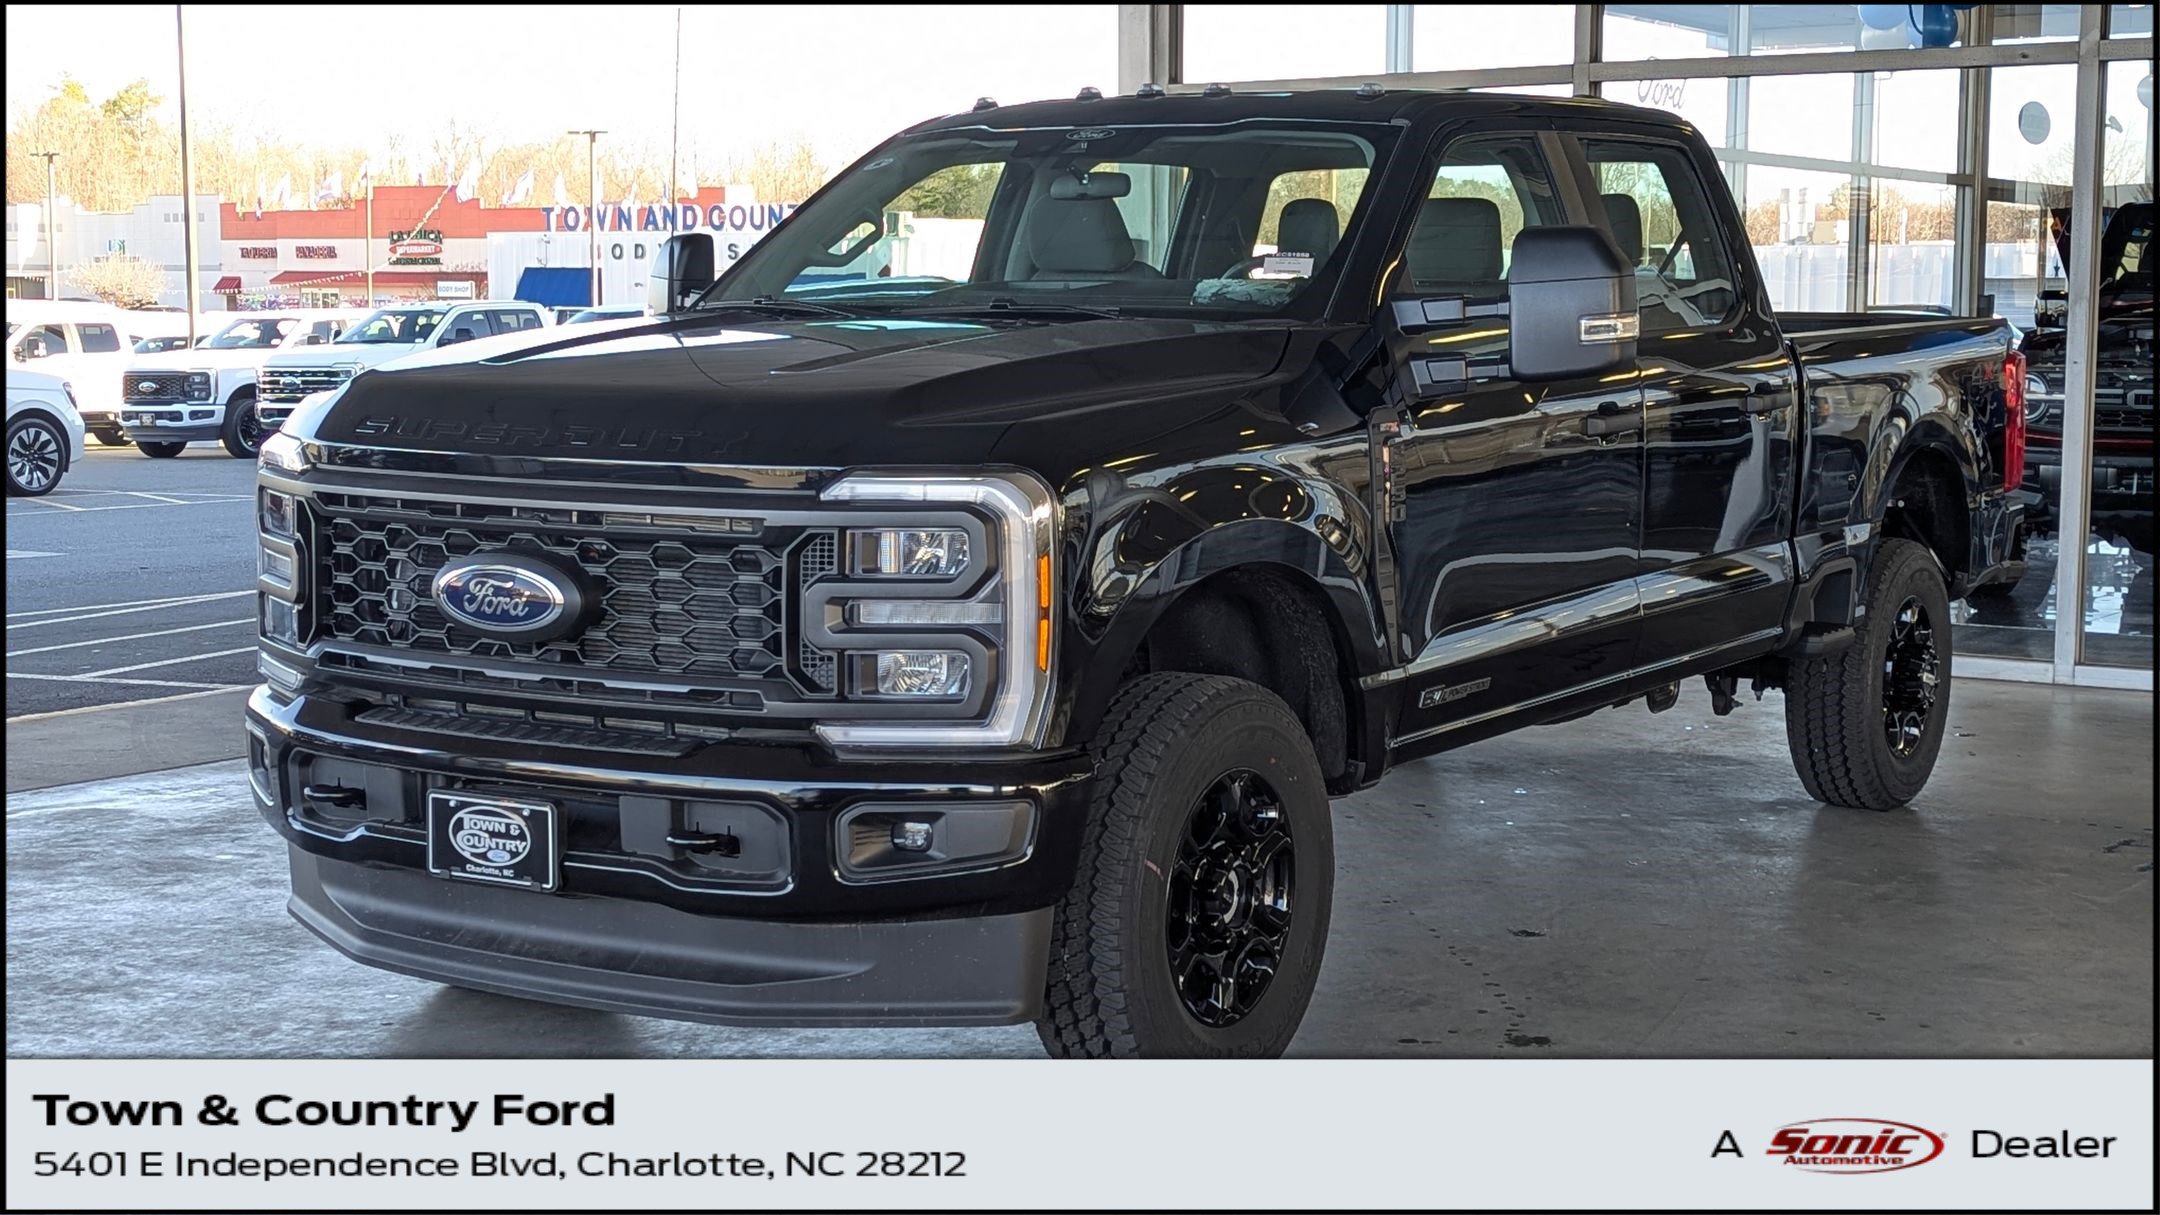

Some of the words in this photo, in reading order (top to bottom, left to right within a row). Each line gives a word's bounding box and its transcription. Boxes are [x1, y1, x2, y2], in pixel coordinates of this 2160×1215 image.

[542, 206, 632, 232] TOWN
[643, 205, 697, 232] AND
[355, 416, 549, 447] SUPER
[462, 577, 529, 617] Ford
[462, 815, 506, 833] TOWN
[509, 824, 521, 836] &
[456, 829, 527, 853] COUNTRY
[503, 868, 515, 878] NC
